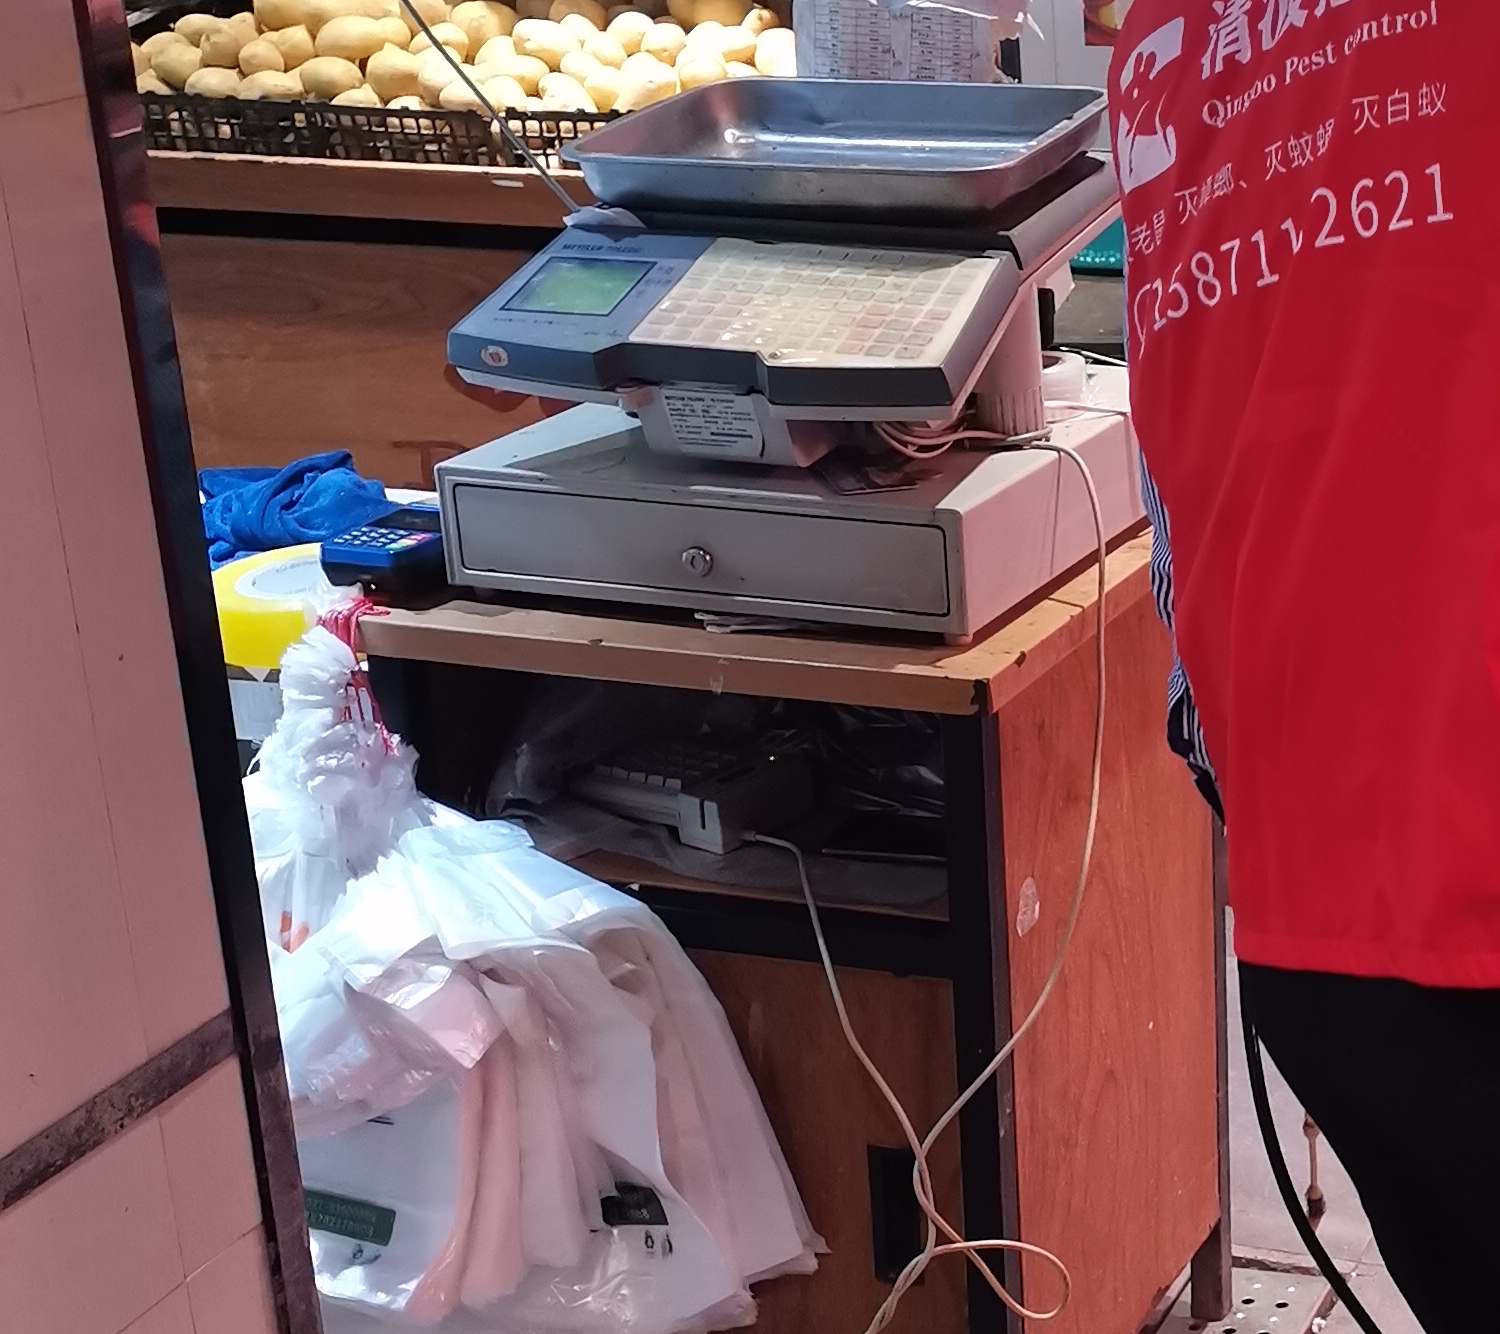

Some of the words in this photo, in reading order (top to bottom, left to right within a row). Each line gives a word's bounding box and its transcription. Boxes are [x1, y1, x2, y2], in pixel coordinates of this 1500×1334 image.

[1285, 41, 1337, 85] Pest
[1352, 82, 1447, 135] 灭白蚁
